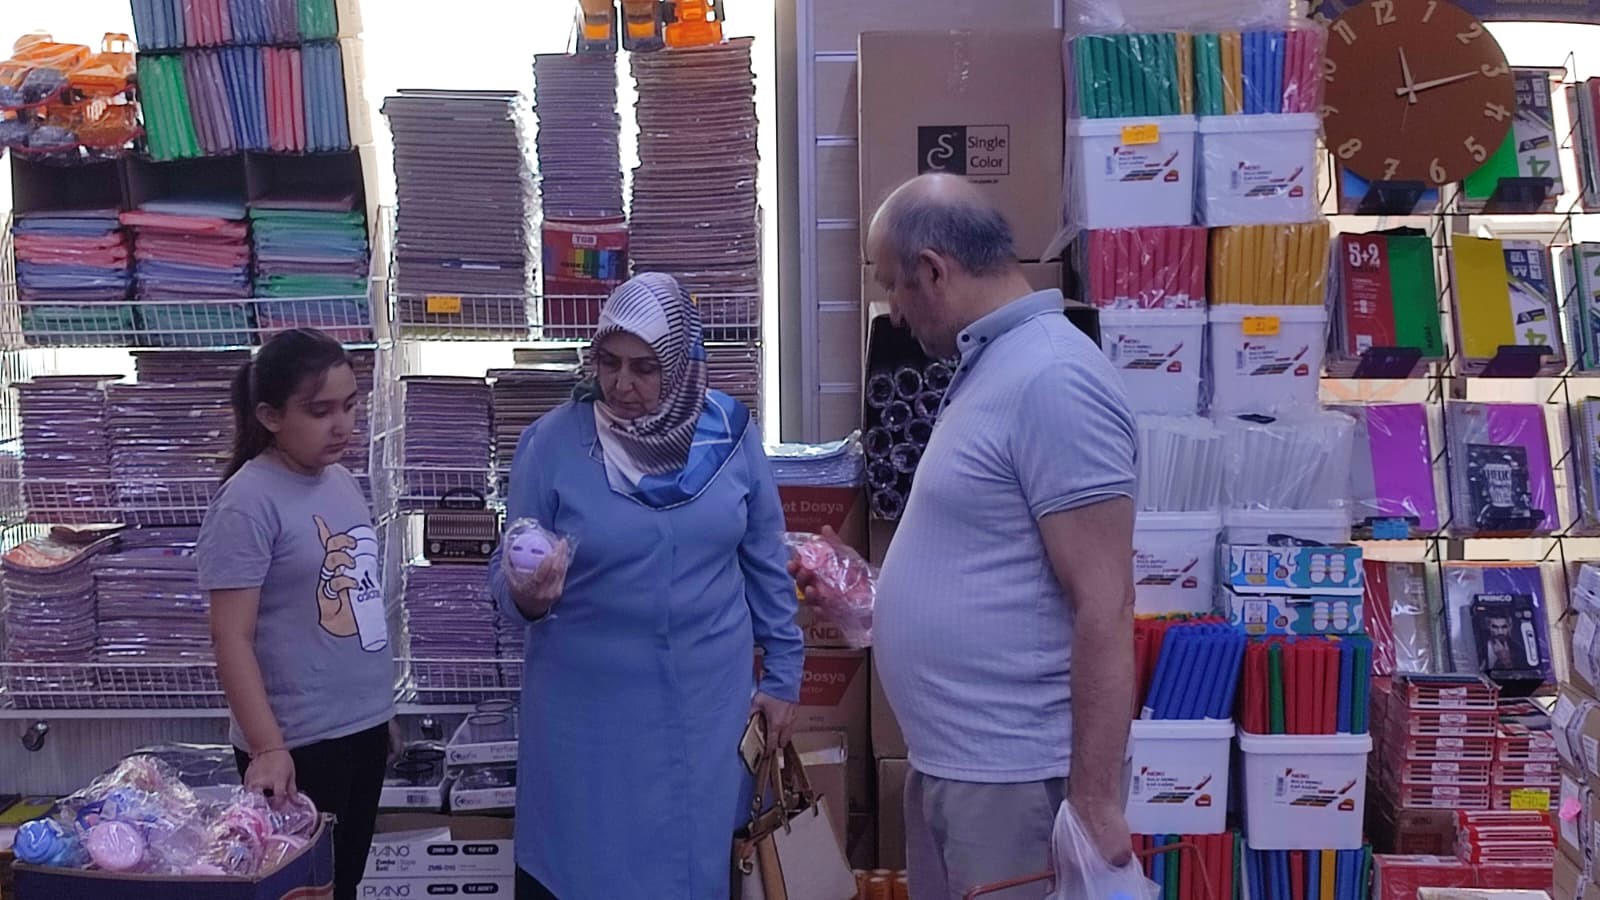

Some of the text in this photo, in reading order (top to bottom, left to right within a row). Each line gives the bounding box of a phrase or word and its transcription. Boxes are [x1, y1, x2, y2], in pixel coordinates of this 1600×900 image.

[1372, 0, 1396, 26] 12
[1422, 0, 1436, 23] 1
[1333, 20, 1356, 45] 11
[1456, 22, 1482, 44] 2
[1481, 63, 1508, 77] 3
[1484, 102, 1510, 122] 4
[968, 136, 1006, 151] Single
[1337, 138, 1363, 160] 8
[1464, 136, 1487, 162] 5
[970, 156, 1003, 168] Color
[1384, 158, 1400, 181] 7
[1429, 158, 1447, 184] 6
[800, 500, 844, 515] Dosya
[803, 671, 846, 685] Dosya
[363, 883, 411, 897] PIANO
